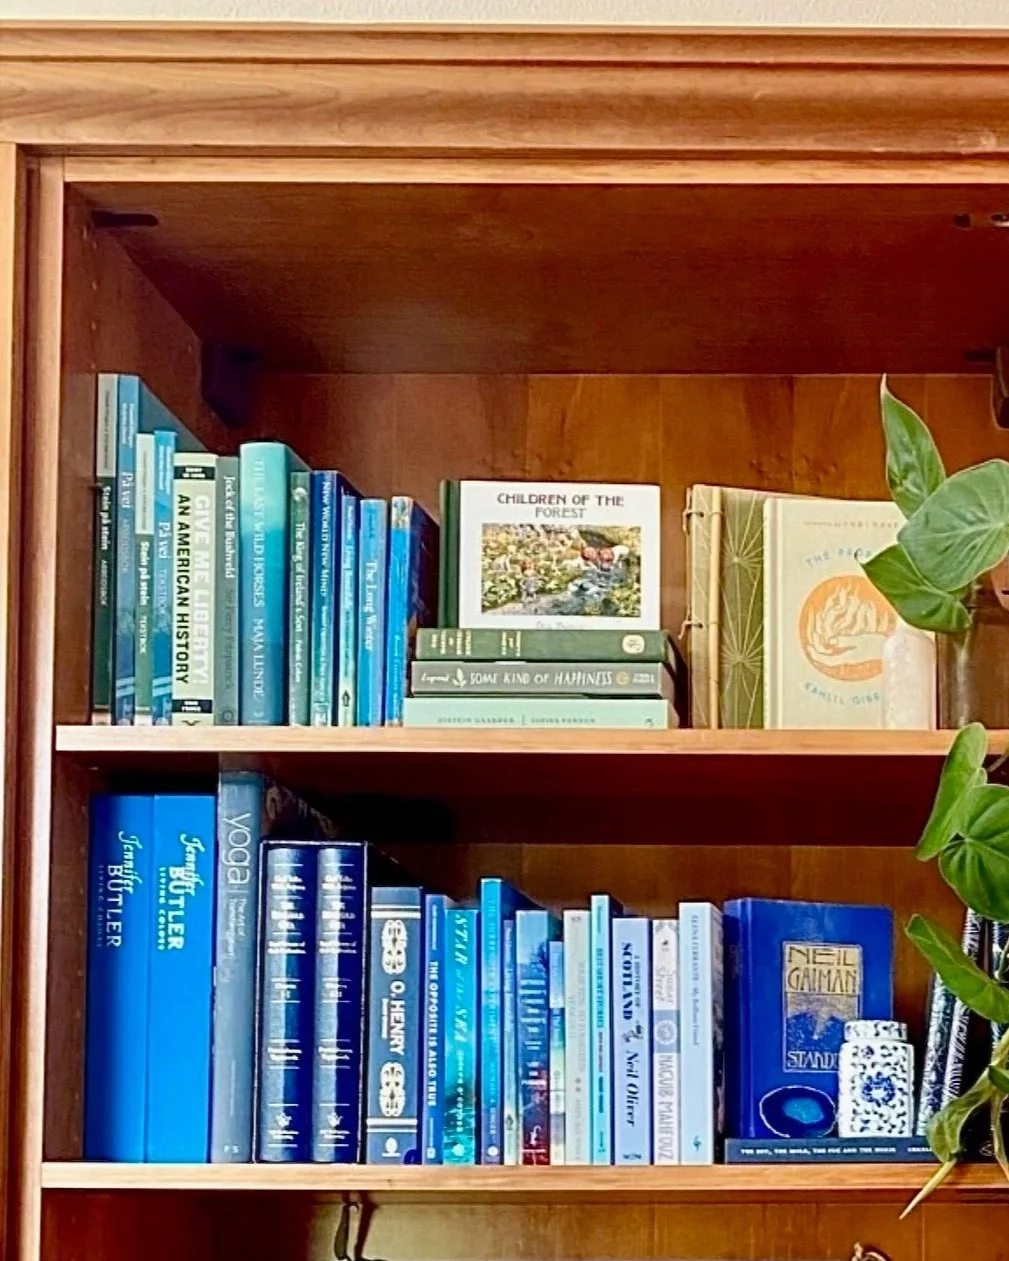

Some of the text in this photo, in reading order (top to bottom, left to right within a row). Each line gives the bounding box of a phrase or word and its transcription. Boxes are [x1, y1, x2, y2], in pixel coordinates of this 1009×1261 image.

[120, 472, 134, 488] På
[497, 493, 624, 506] CHILDREN OF THE
[535, 507, 586, 519] FOREST
[100, 486, 112, 550] Stein på stein
[158, 520, 172, 560] På vei
[224, 476, 235, 578] Jock of the Bushveld
[137, 542, 150, 606] Stein på stein
[175, 494, 190, 685] AN AMERICAN HISTORY
[194, 495, 210, 685] GIVE ME LIBERTY!
[254, 521, 264, 608] WILD HORSES
[292, 522, 305, 632] The King of Son
[364, 560, 377, 652] The Long Winter
[251, 618, 264, 699] MAJA LUNDE
[470, 672, 613, 686] SOME KIND OF HAPPINESS
[119, 831, 143, 894] Jennifer
[180, 834, 204, 896] Jennifer
[222, 812, 252, 884] yoga
[106, 865, 122, 947] BUTLER
[168, 866, 185, 950] BUTLER
[622, 942, 632, 1020] SCOTLAND
[788, 947, 856, 966] NEIL
[788, 968, 857, 993] GAIMAN
[388, 981, 404, 1056] O. HENRY
[428, 961, 440, 1107] THE OPPOSITE IS ALSO TRUE
[625, 1050, 640, 1126] Neil Oliver
[659, 1055, 672, 1160] NAGUIB MAHFOUZ
